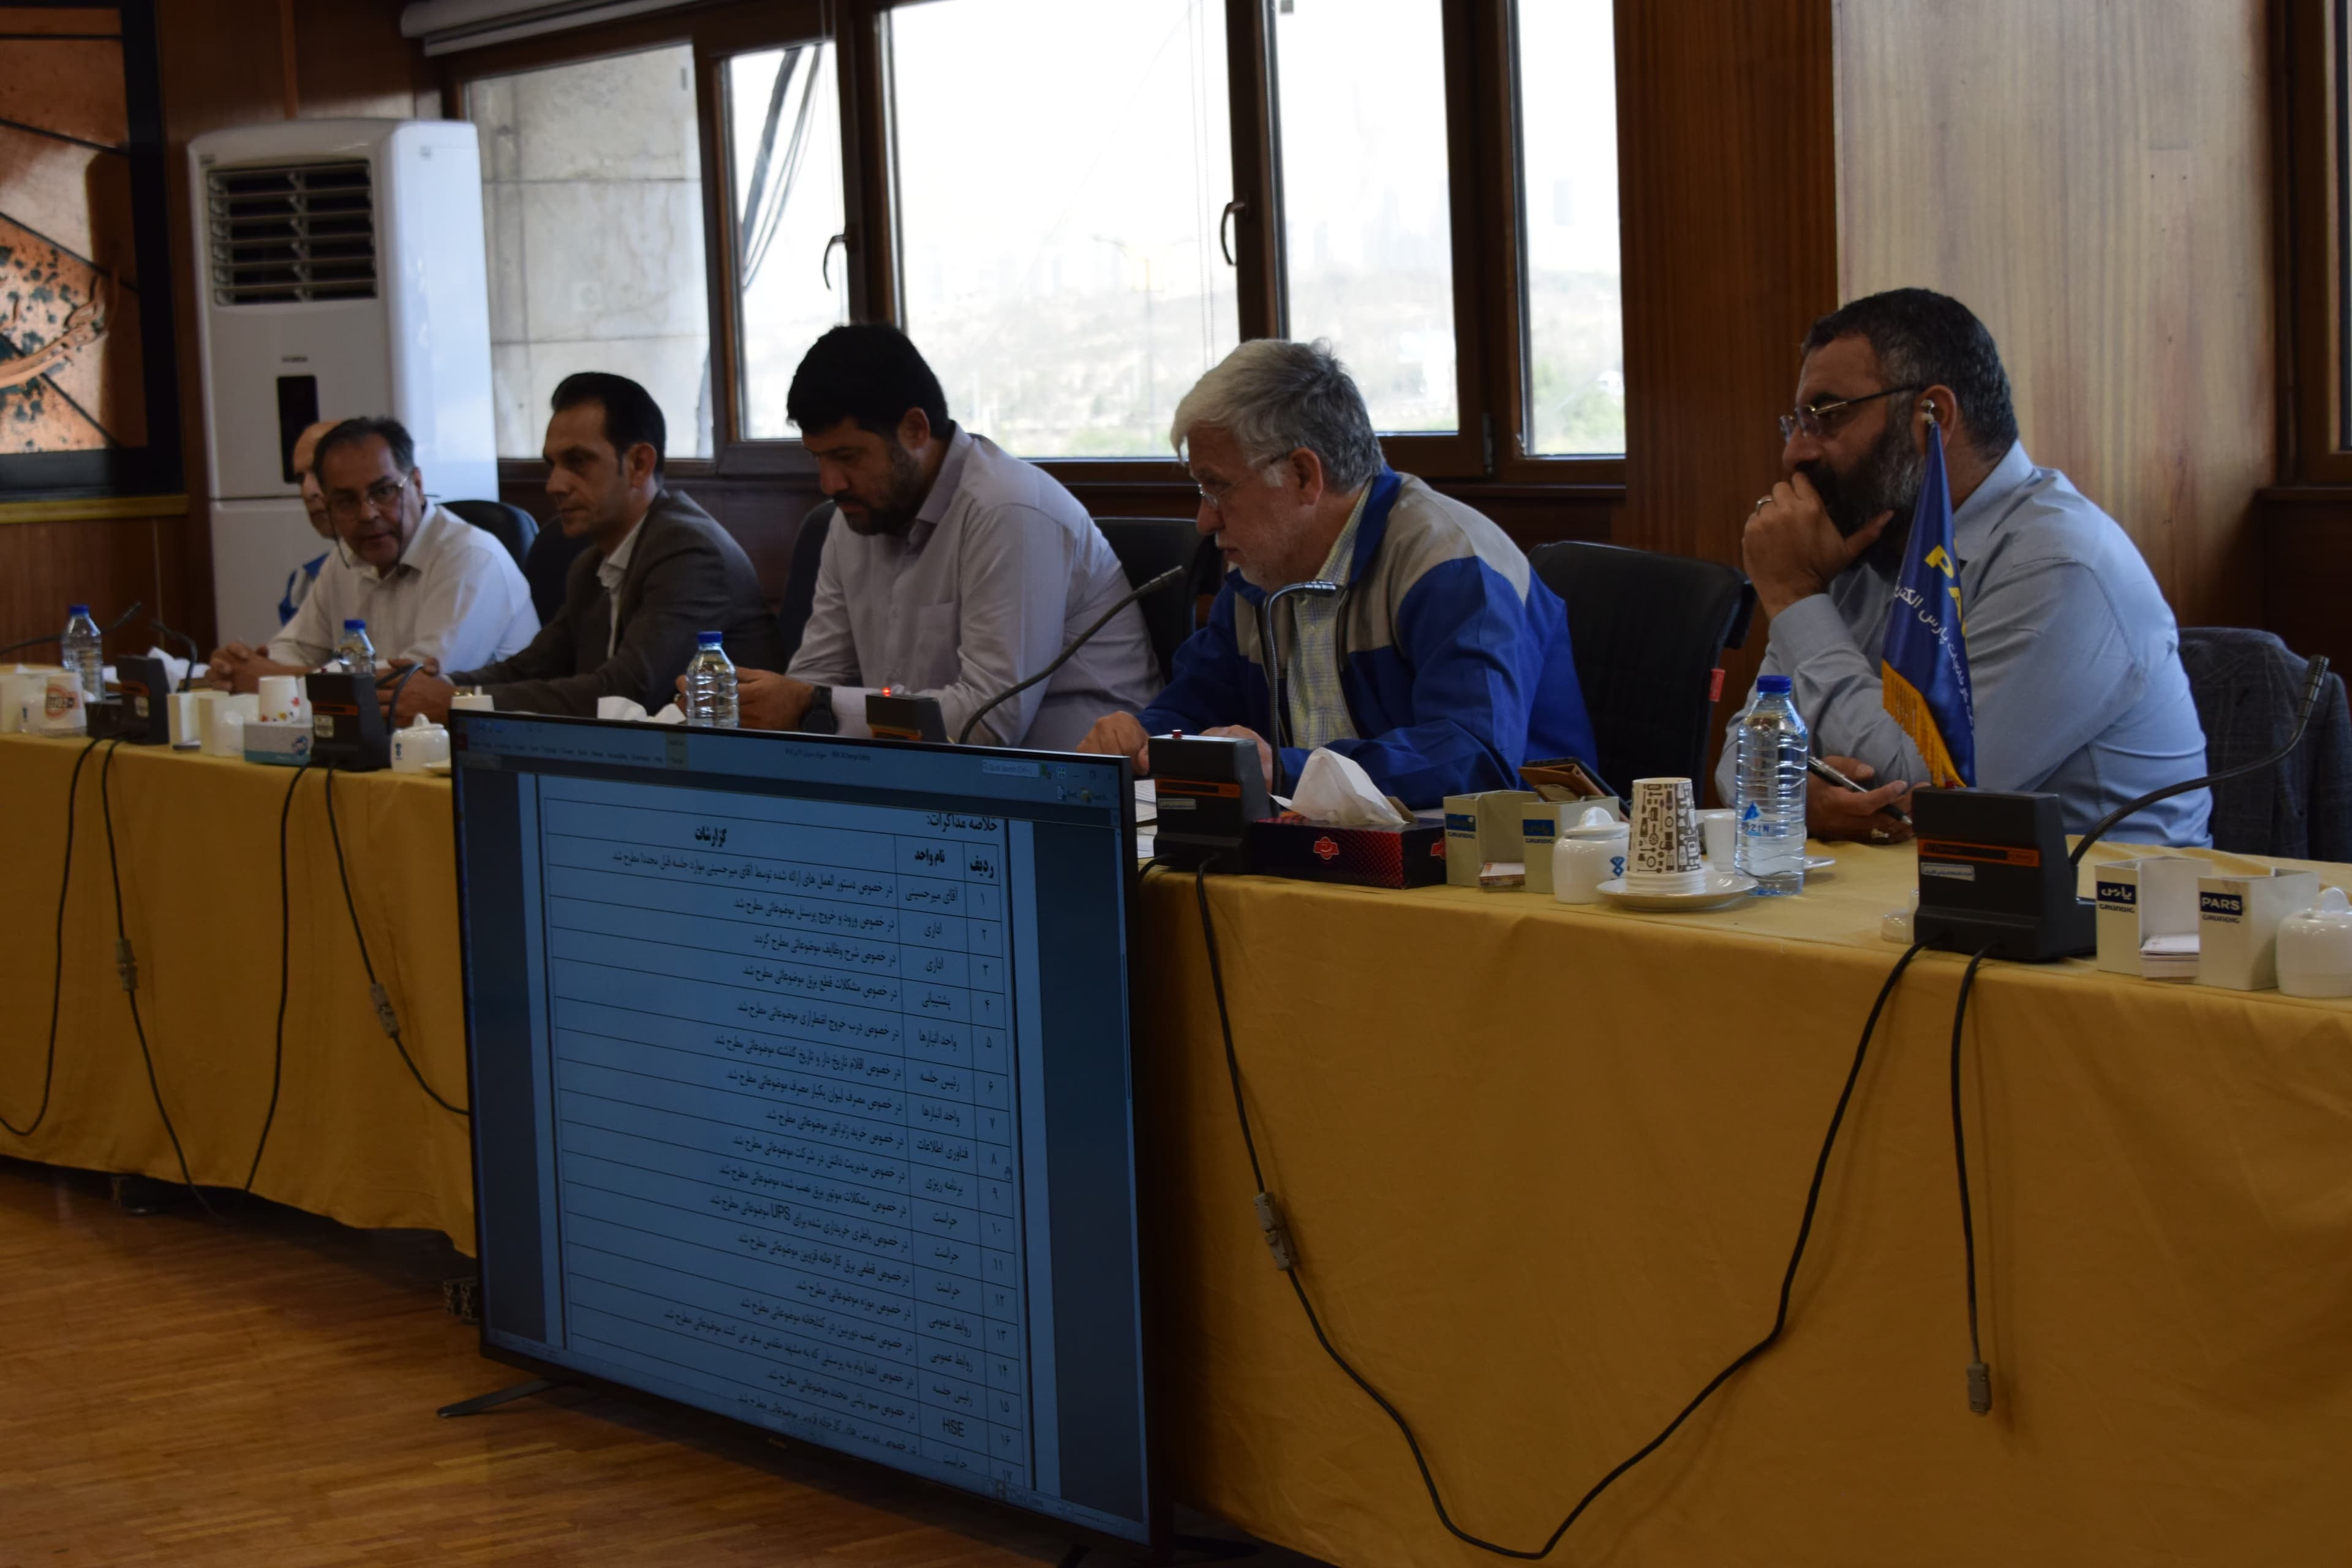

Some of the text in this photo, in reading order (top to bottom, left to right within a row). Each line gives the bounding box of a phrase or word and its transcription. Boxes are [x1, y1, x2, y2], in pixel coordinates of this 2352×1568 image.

[1918, 609, 1948, 644] پارس
[2101, 886, 2133, 900] پارس
[2099, 903, 2135, 913] GRUNDIG
[2201, 897, 2239, 911] PARS
[2202, 914, 2240, 924] GRUNDIG
[770, 1202, 791, 1221] UPS
[942, 1416, 965, 1438] HSE
